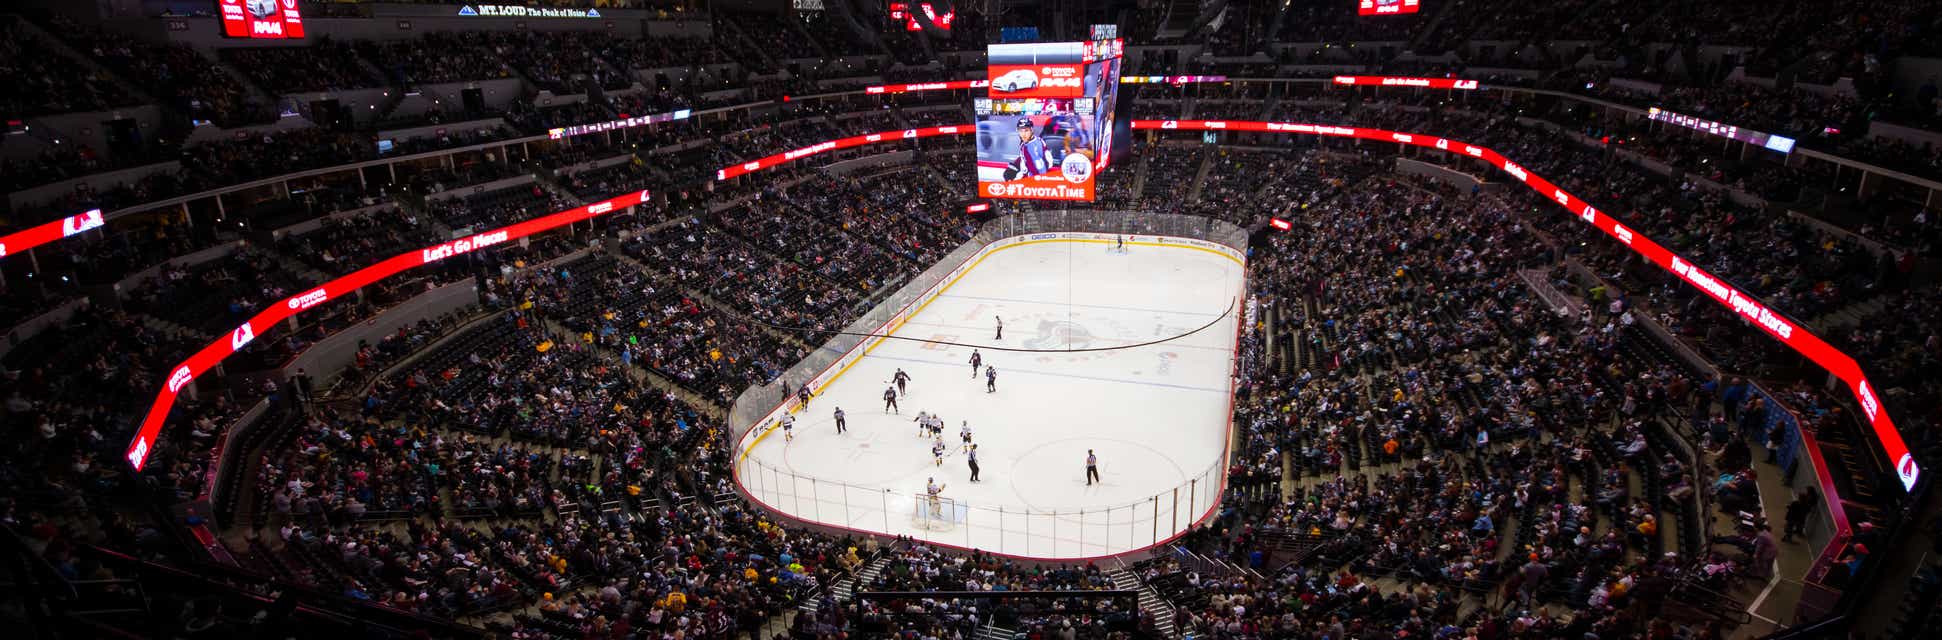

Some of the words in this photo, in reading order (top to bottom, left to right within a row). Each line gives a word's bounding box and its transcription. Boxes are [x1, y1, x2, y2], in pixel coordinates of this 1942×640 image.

[479, 5, 498, 15] MT.
[500, 5, 526, 16] LOUD
[527, 8, 540, 16] The
[542, 8, 559, 17] Peak
[560, 9, 567, 17] of
[568, 9, 586, 17] Noise
[254, 21, 282, 35] RAV4
[423, 244, 453, 263] Let's
[454, 240, 471, 254] Go
[473, 230, 508, 249] Places
[299, 288, 327, 304] TOYOTA
[1671, 256, 1689, 276] Your
[1687, 266, 1729, 301] Hometown
[1728, 289, 1761, 319] Toyota
[1758, 308, 1793, 339] Stores
